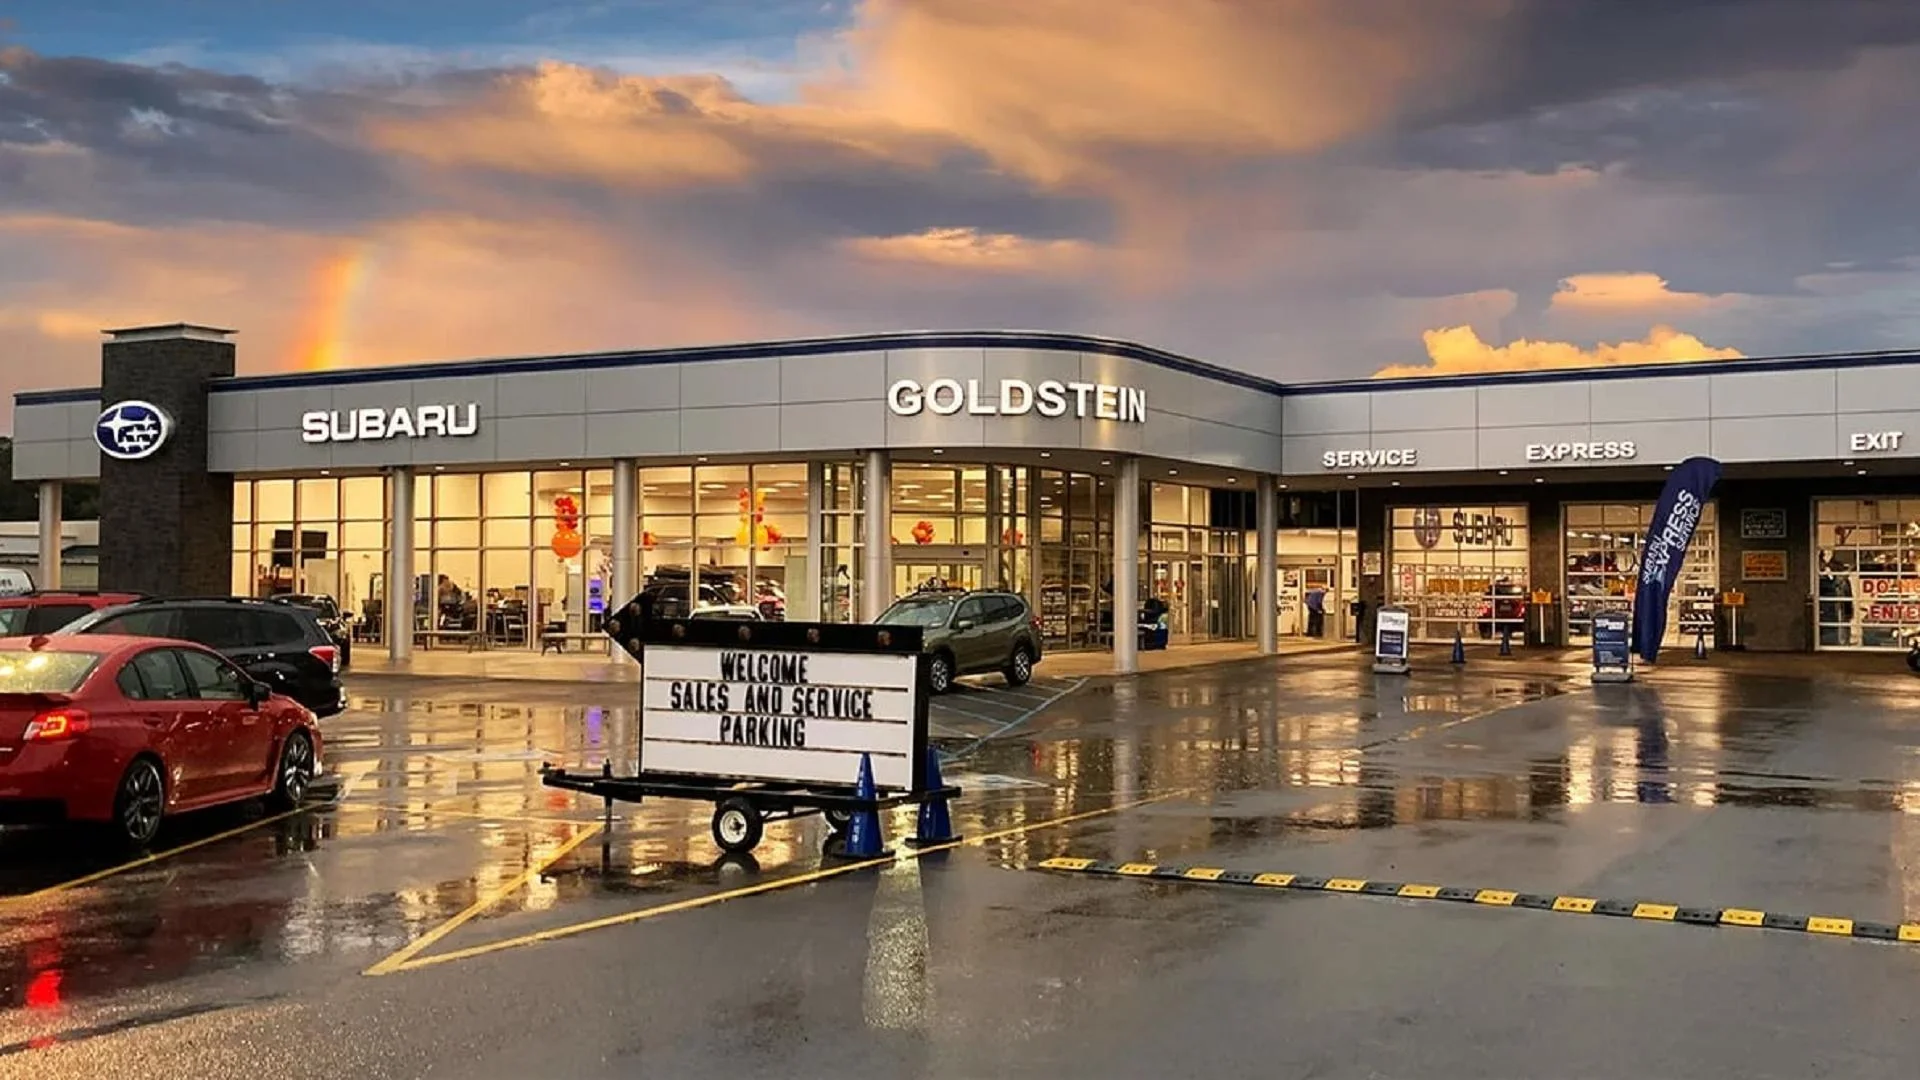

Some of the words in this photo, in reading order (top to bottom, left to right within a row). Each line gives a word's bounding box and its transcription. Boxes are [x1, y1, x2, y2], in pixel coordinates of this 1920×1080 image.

[888, 378, 1146, 423] GOLDSTEIN
[302, 403, 477, 442] SUBARU
[1525, 441, 1636, 461] EXPRESS
[1850, 431, 1903, 451] EXIT
[1322, 448, 1417, 467] SERVICE
[1452, 511, 1513, 546] SUBARU
[1676, 498, 1701, 551] SERVICE
[1863, 580, 1889, 594] DO
[720, 652, 808, 683] WELCOME
[671, 682, 730, 711] SALES
[745, 686, 782, 713] AND
[792, 687, 873, 719] SERVICE
[719, 716, 806, 747] PARKING
